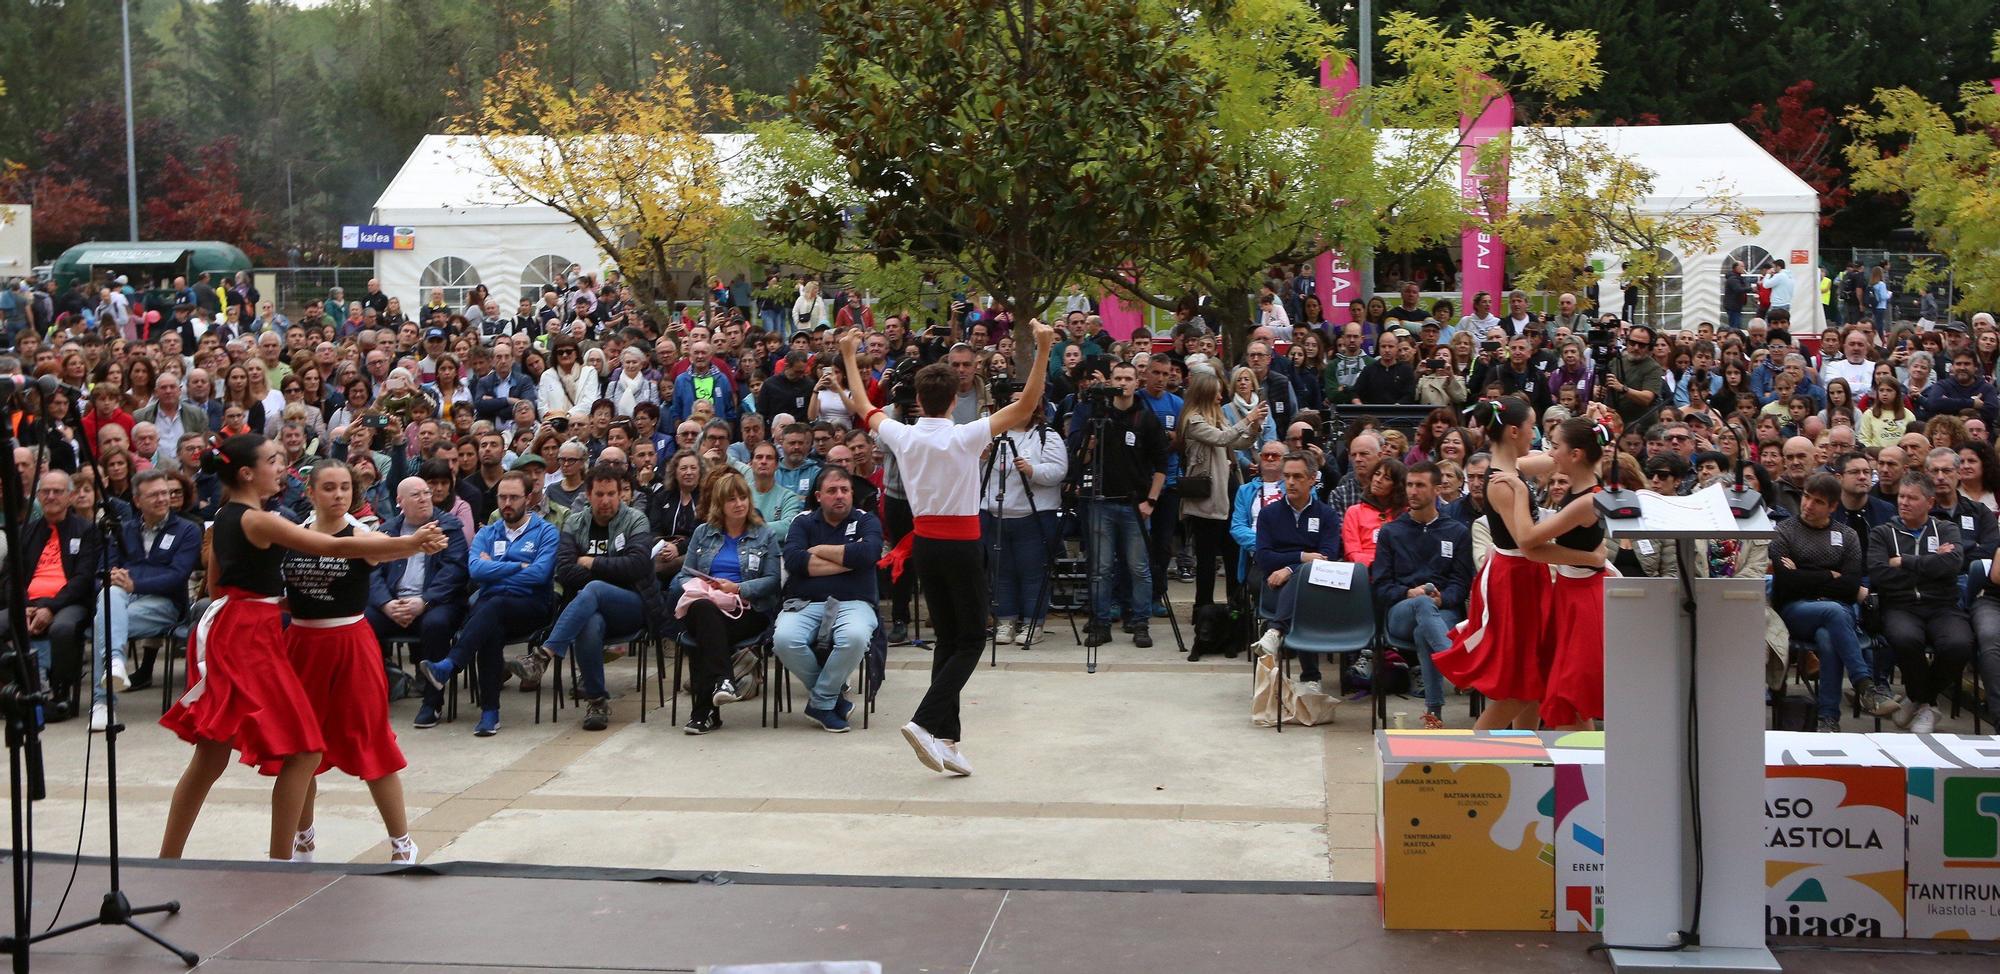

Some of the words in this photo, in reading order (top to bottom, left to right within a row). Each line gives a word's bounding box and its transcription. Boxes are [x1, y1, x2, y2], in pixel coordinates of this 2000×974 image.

[360, 232, 390, 243] kafea
[1764, 827, 1883, 849] ASTOLA
[1928, 903, 1977, 916] Ikastola
